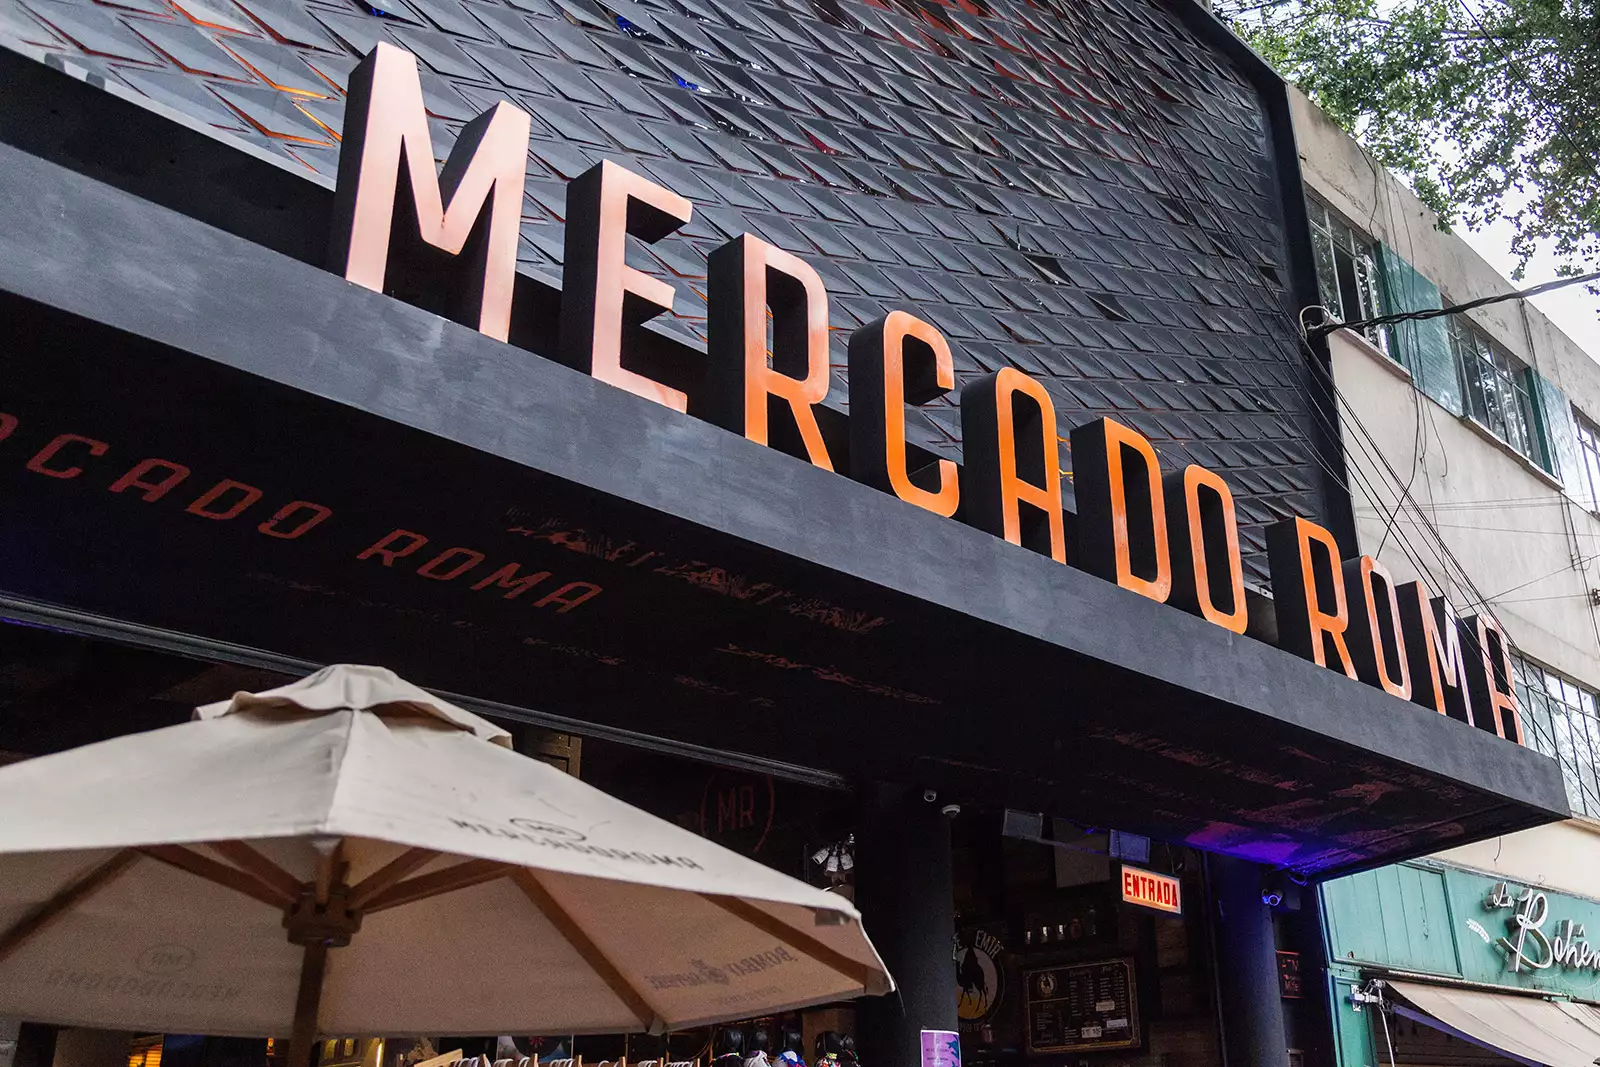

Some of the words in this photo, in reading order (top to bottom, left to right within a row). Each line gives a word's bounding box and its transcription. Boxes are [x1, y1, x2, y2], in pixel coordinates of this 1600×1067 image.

[345, 41, 1249, 636] MERCADO
[1294, 516, 1526, 748] ROMA
[0, 411, 333, 539] CADO
[356, 529, 603, 614] ROMA
[716, 784, 755, 833] MR
[1124, 872, 1178, 907] ENTRADA
[1491, 881, 1515, 908] La
